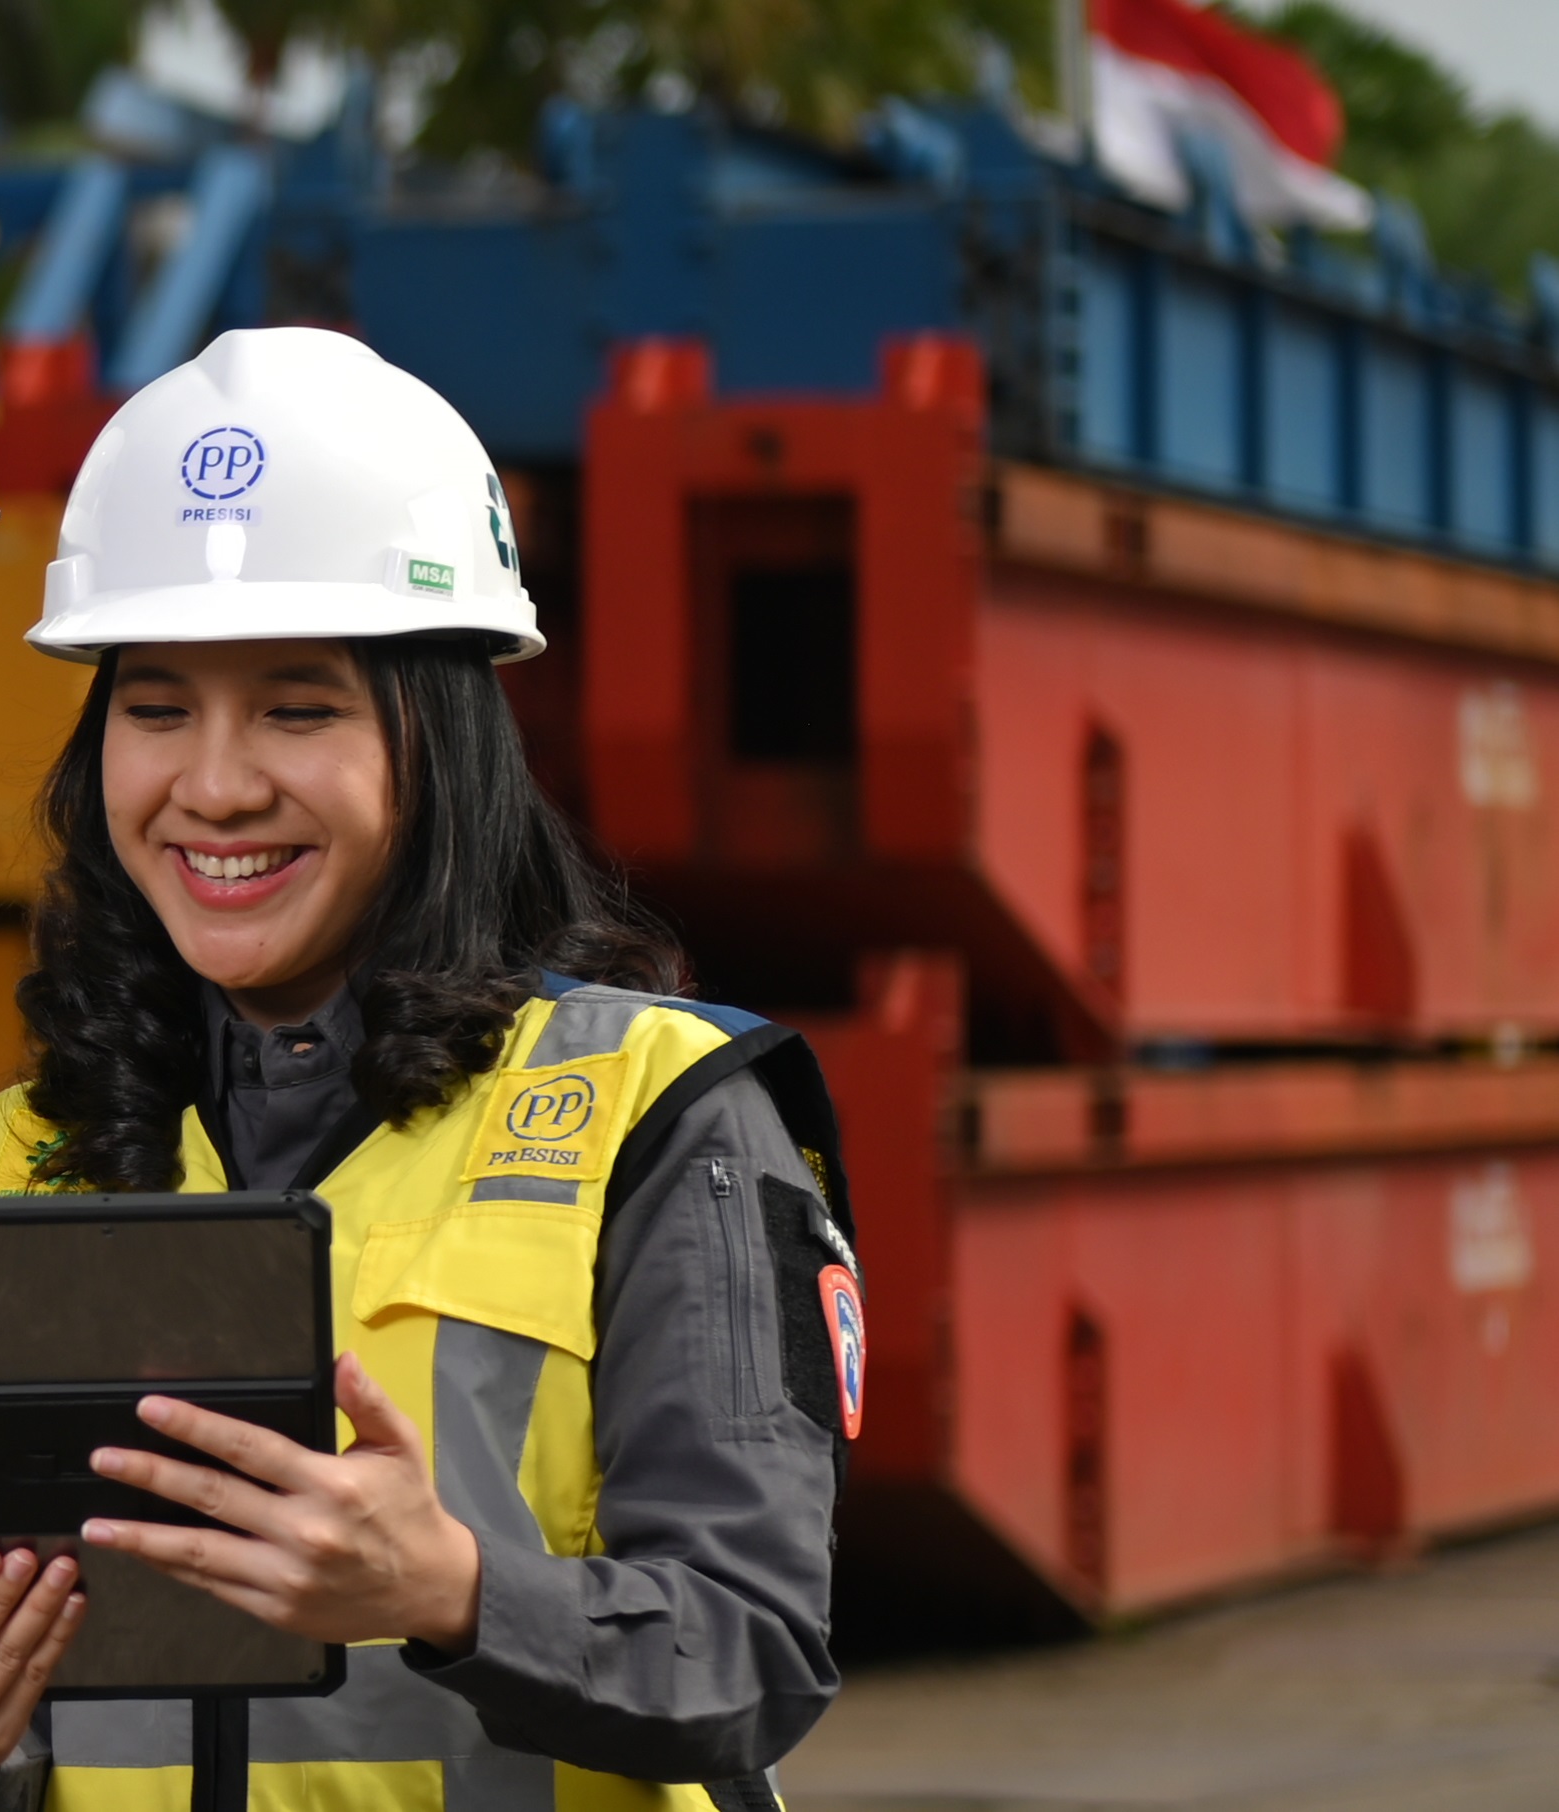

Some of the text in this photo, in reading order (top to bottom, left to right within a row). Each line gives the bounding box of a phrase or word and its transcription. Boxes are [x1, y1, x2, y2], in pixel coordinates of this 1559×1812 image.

[195, 445, 253, 481] PP
[182, 507, 251, 522] PRESISI
[411, 563, 453, 586] MSA
[518, 1091, 584, 1128] PP
[487, 1147, 582, 1167] PRESISI
